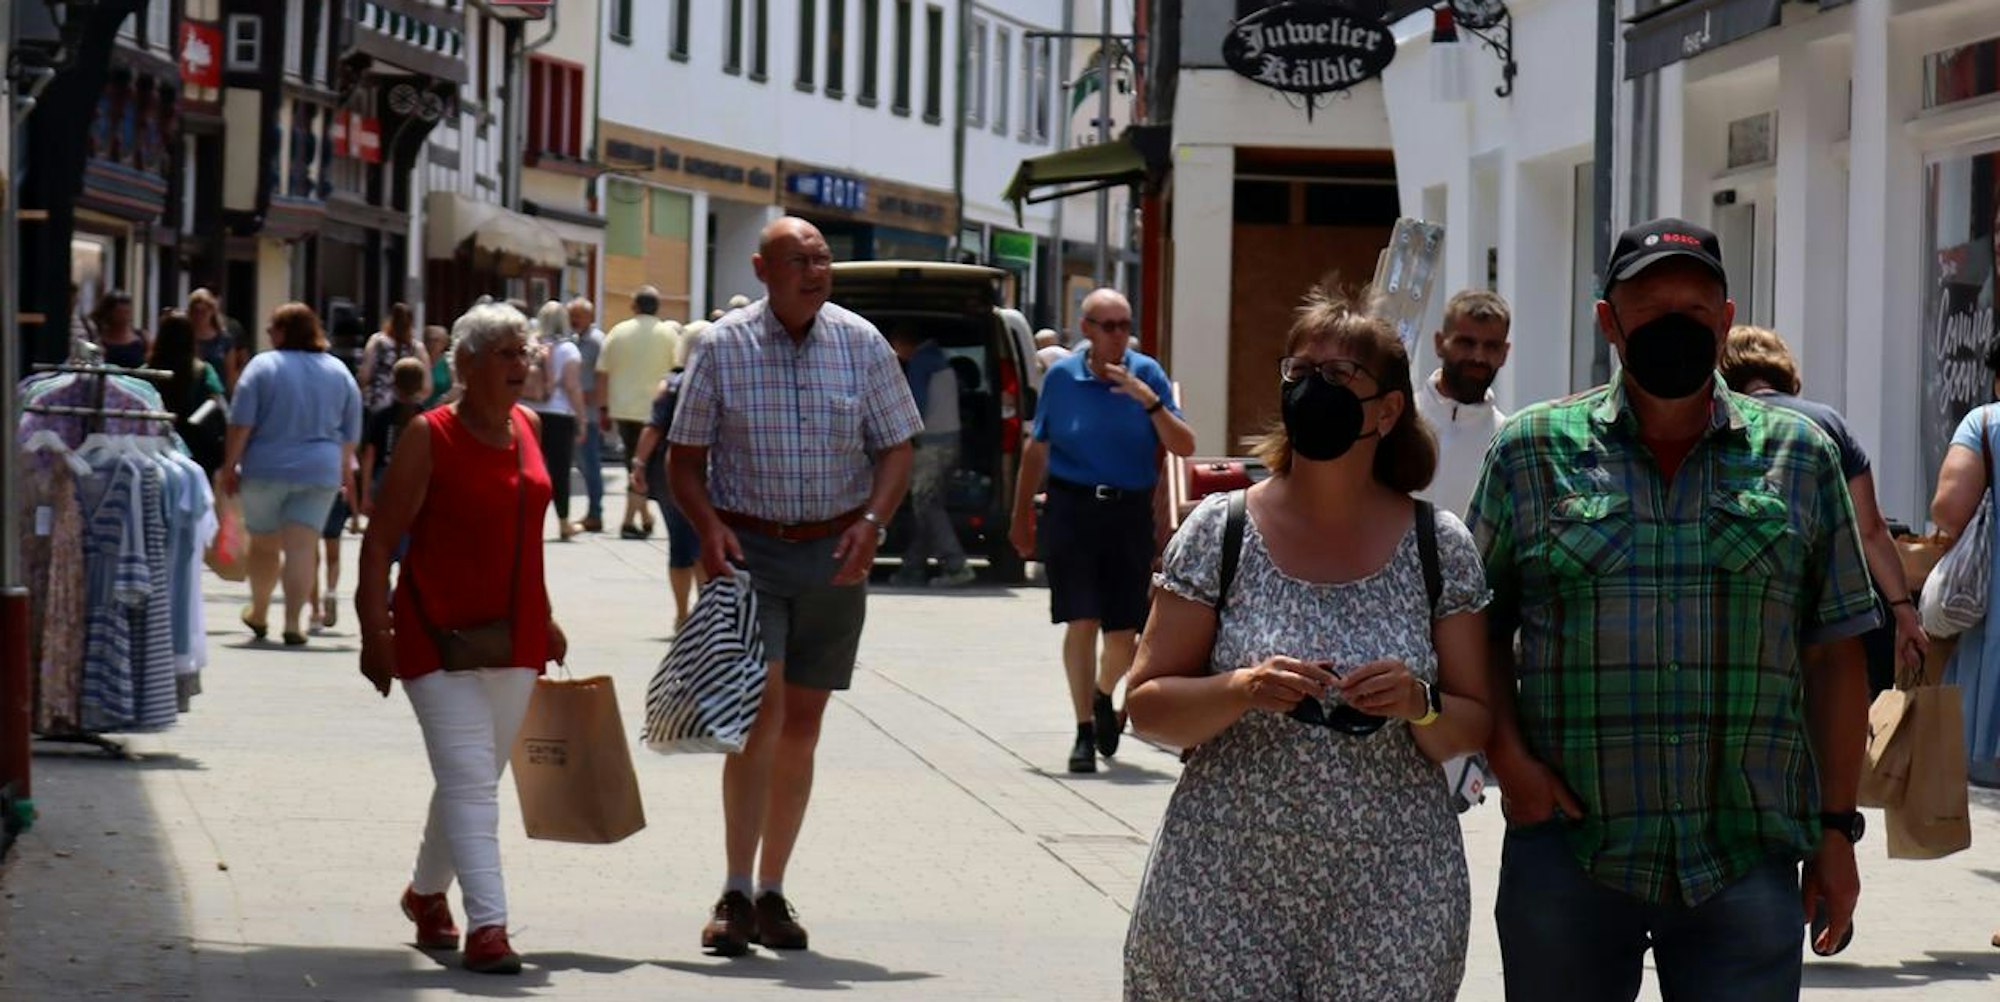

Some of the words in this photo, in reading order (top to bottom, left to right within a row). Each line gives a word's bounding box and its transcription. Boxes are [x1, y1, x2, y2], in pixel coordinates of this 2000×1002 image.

[1238, 18, 1382, 58] Juwelier
[1254, 53, 1363, 86] Kälble
[1662, 232, 1701, 247] BOSCH
[1936, 288, 1993, 361] Coming
